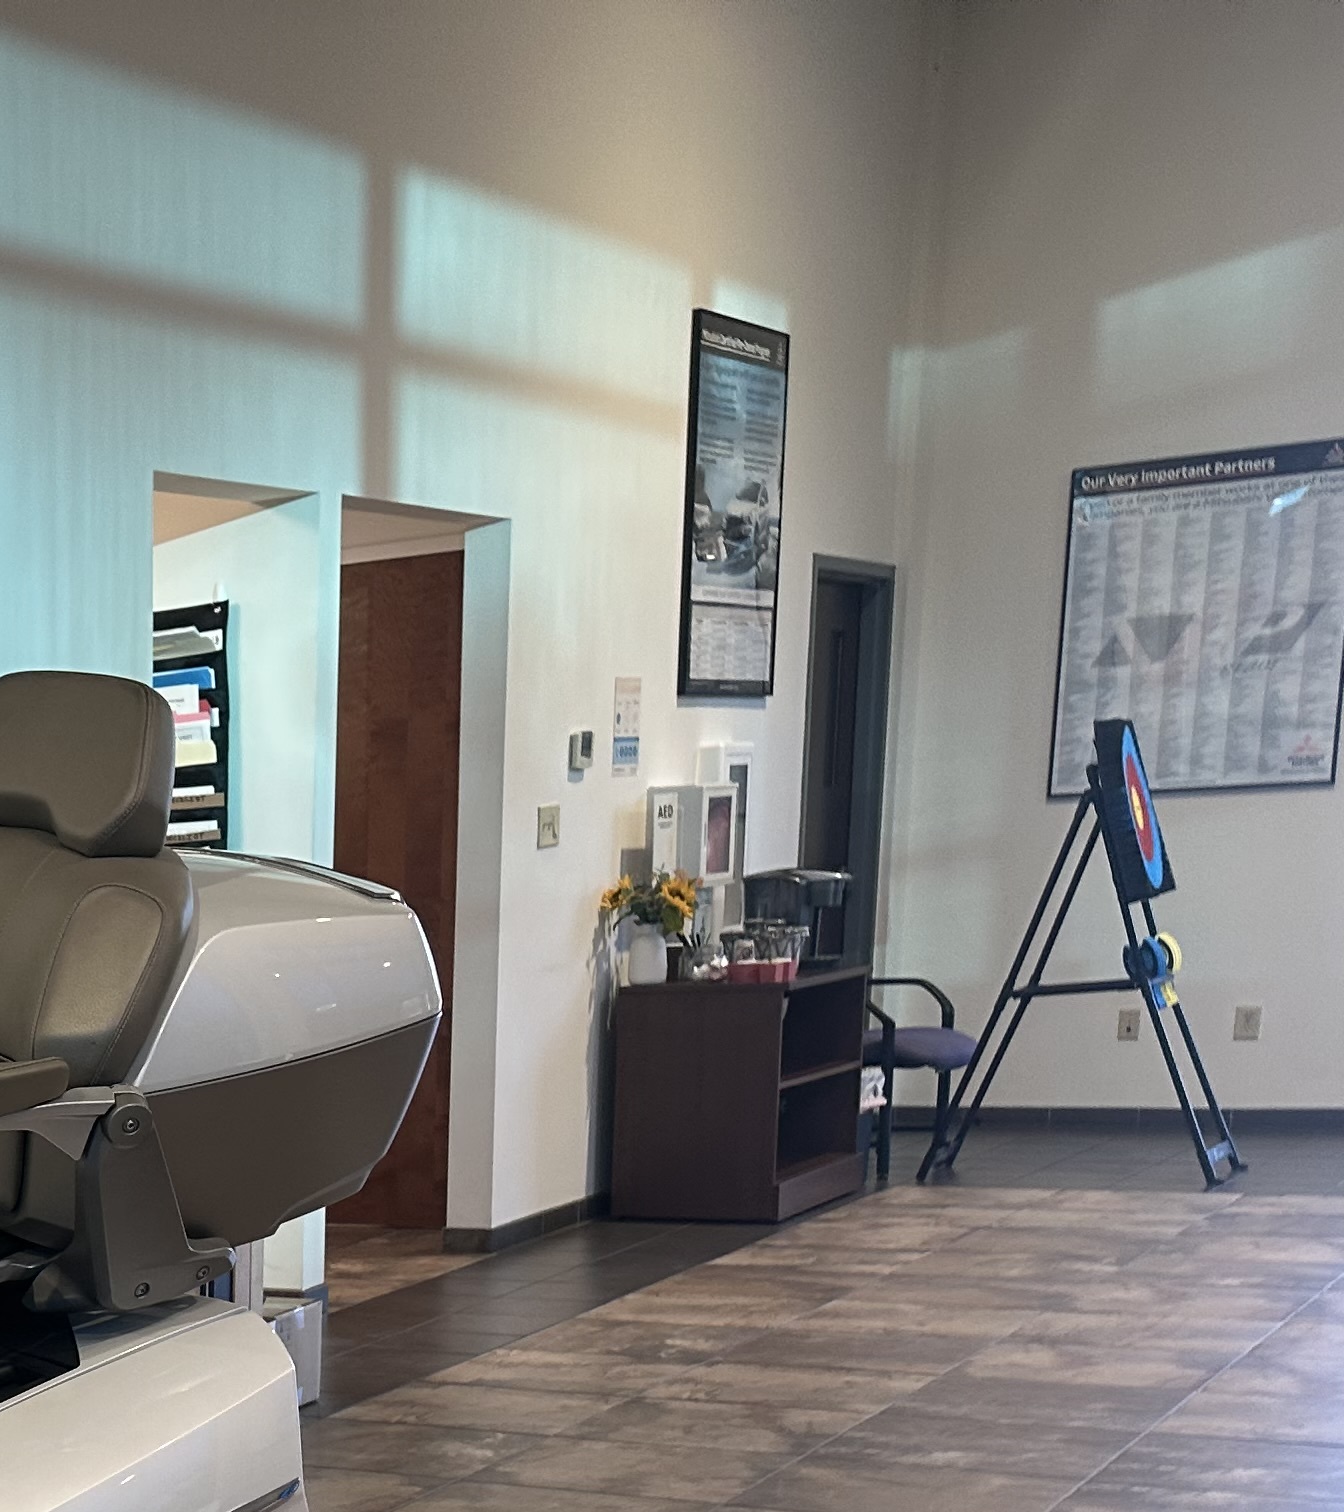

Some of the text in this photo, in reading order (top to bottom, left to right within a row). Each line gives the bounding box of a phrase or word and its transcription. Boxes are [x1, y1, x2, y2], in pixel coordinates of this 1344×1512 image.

[1081, 456, 1276, 490] Our Very Important Partners
